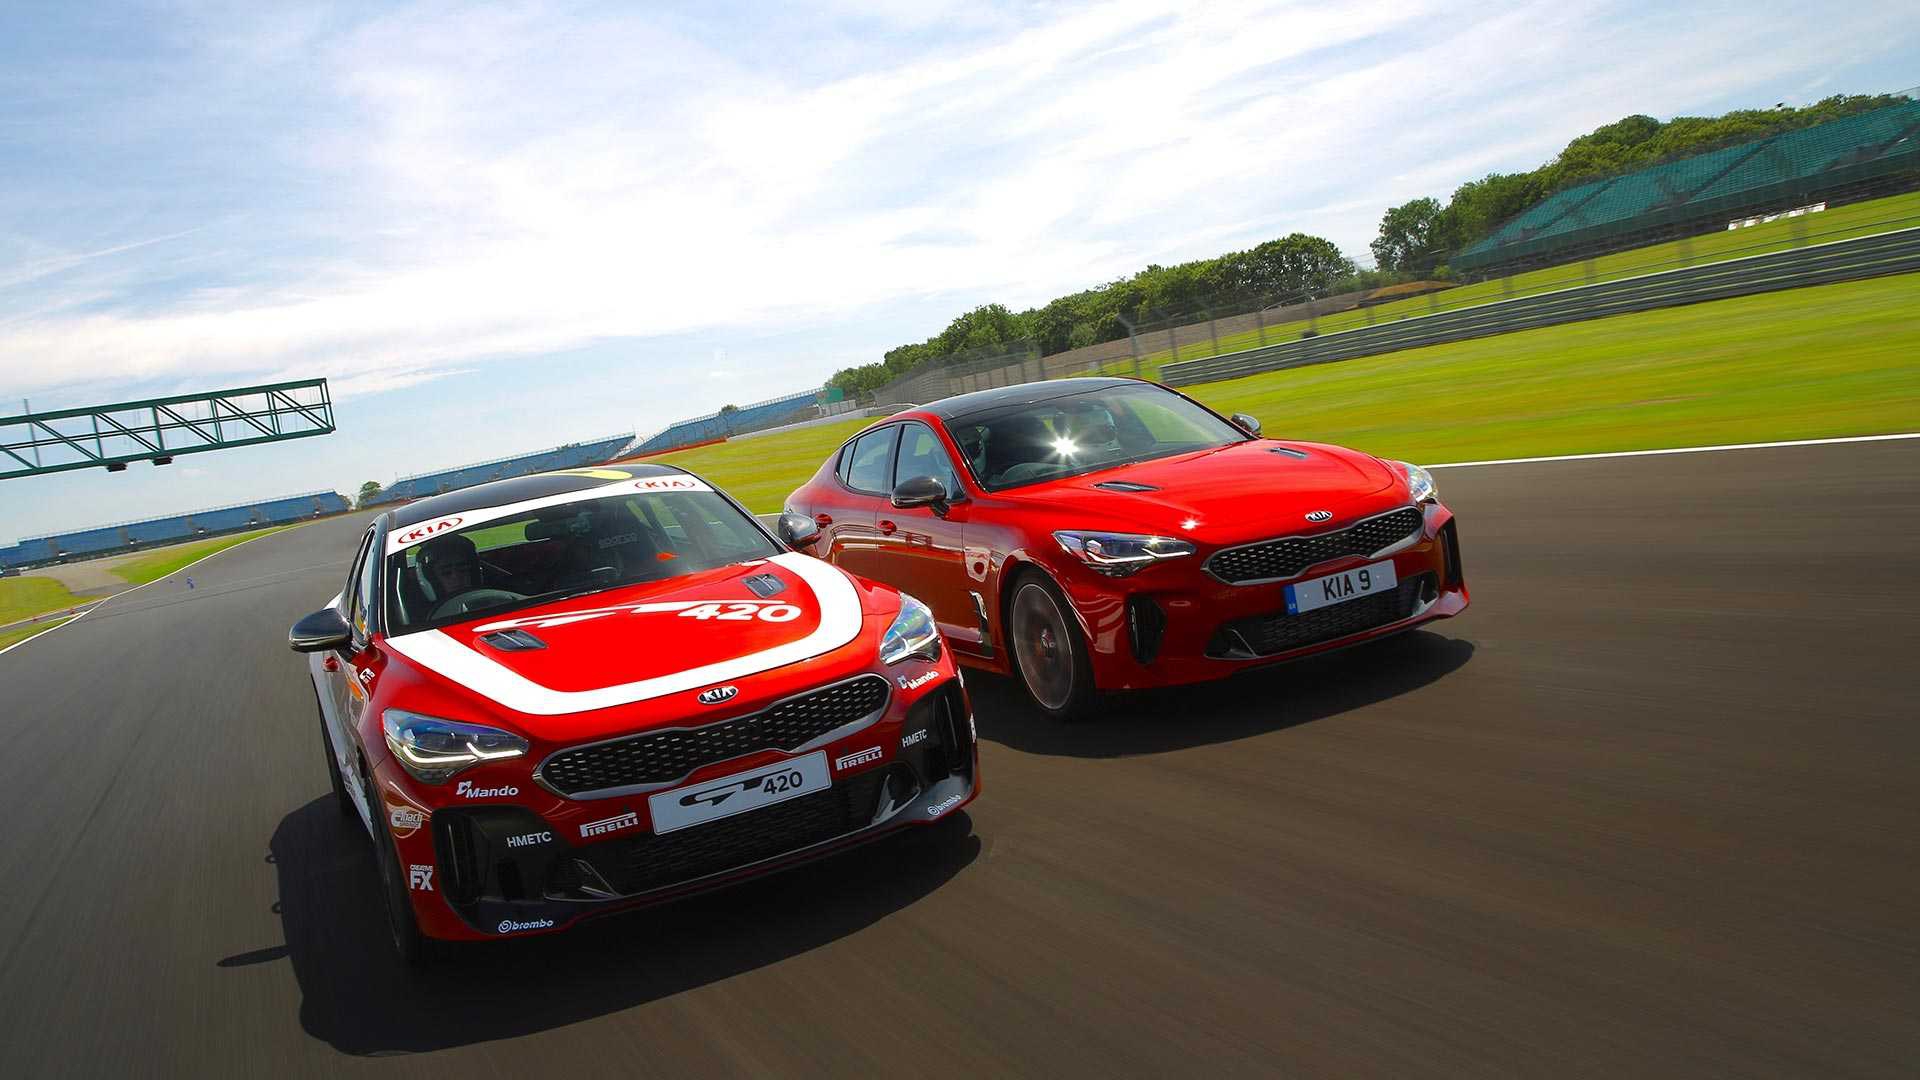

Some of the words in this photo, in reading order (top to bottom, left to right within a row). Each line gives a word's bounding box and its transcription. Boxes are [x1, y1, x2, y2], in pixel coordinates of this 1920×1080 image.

[644, 480, 687, 489] KIA
[1309, 510, 1330, 521] KIA
[408, 520, 453, 540] KIA
[1322, 574, 1355, 601] KIA
[1358, 569, 1372, 591] 9
[907, 671, 939, 690] Mando
[702, 686, 734, 701] KIA
[902, 729, 928, 748] HMETC
[836, 746, 883, 771] PIRELLI
[465, 785, 519, 798] Mando
[579, 812, 639, 837] PIRELLI
[506, 831, 552, 848] HMETC
[410, 871, 434, 891] FX
